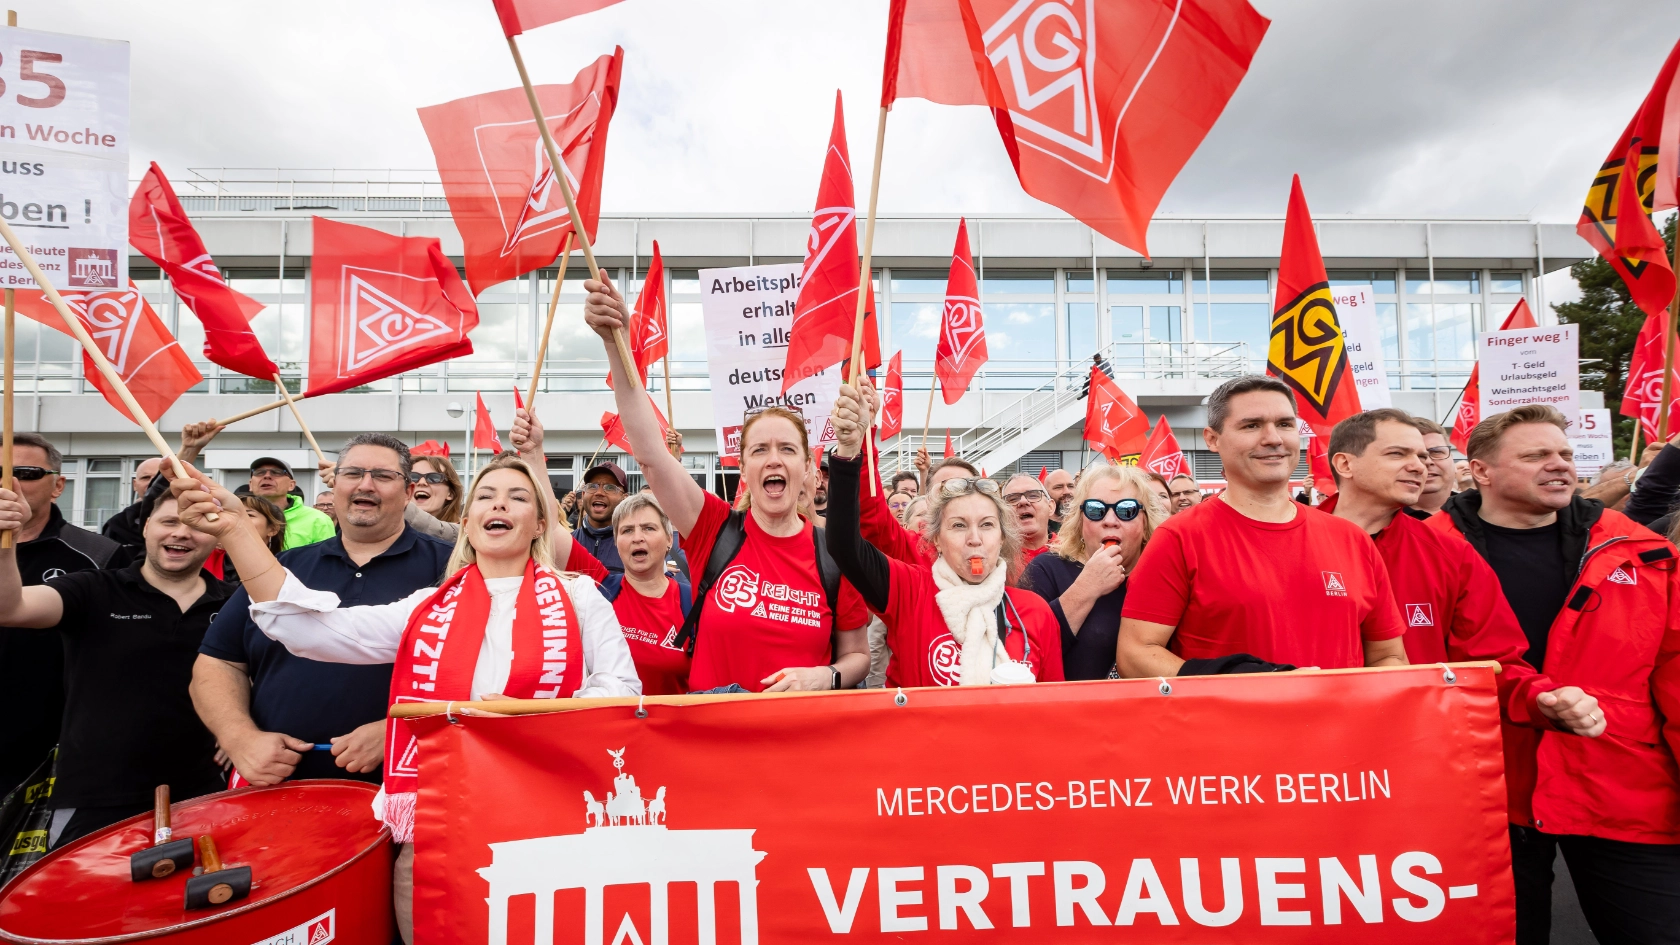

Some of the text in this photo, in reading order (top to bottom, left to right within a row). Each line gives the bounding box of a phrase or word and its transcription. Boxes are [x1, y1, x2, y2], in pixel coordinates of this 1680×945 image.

[0, 50, 66, 109] 5
[25, 123, 116, 148] Woche
[739, 331, 756, 346] in
[1487, 330, 1569, 347] Finger weg !
[1523, 361, 1545, 369] Geld
[1500, 371, 1557, 381] Urlaubsgeld
[1491, 383, 1566, 395] Weihnachtsgeld
[743, 392, 816, 409] Werken
[1488, 395, 1570, 406] Sonderzahlungen
[1579, 414, 1596, 430] 5
[723, 573, 820, 608] 35 REICHT
[769, 603, 820, 619] KEINE ZEIT FÜR
[769, 612, 820, 628] NEUE MAUERN
[877, 769, 1391, 816] MERCEDES-BENZ WERK BERLIN
[807, 850, 1478, 935] VERTRAUENS-
